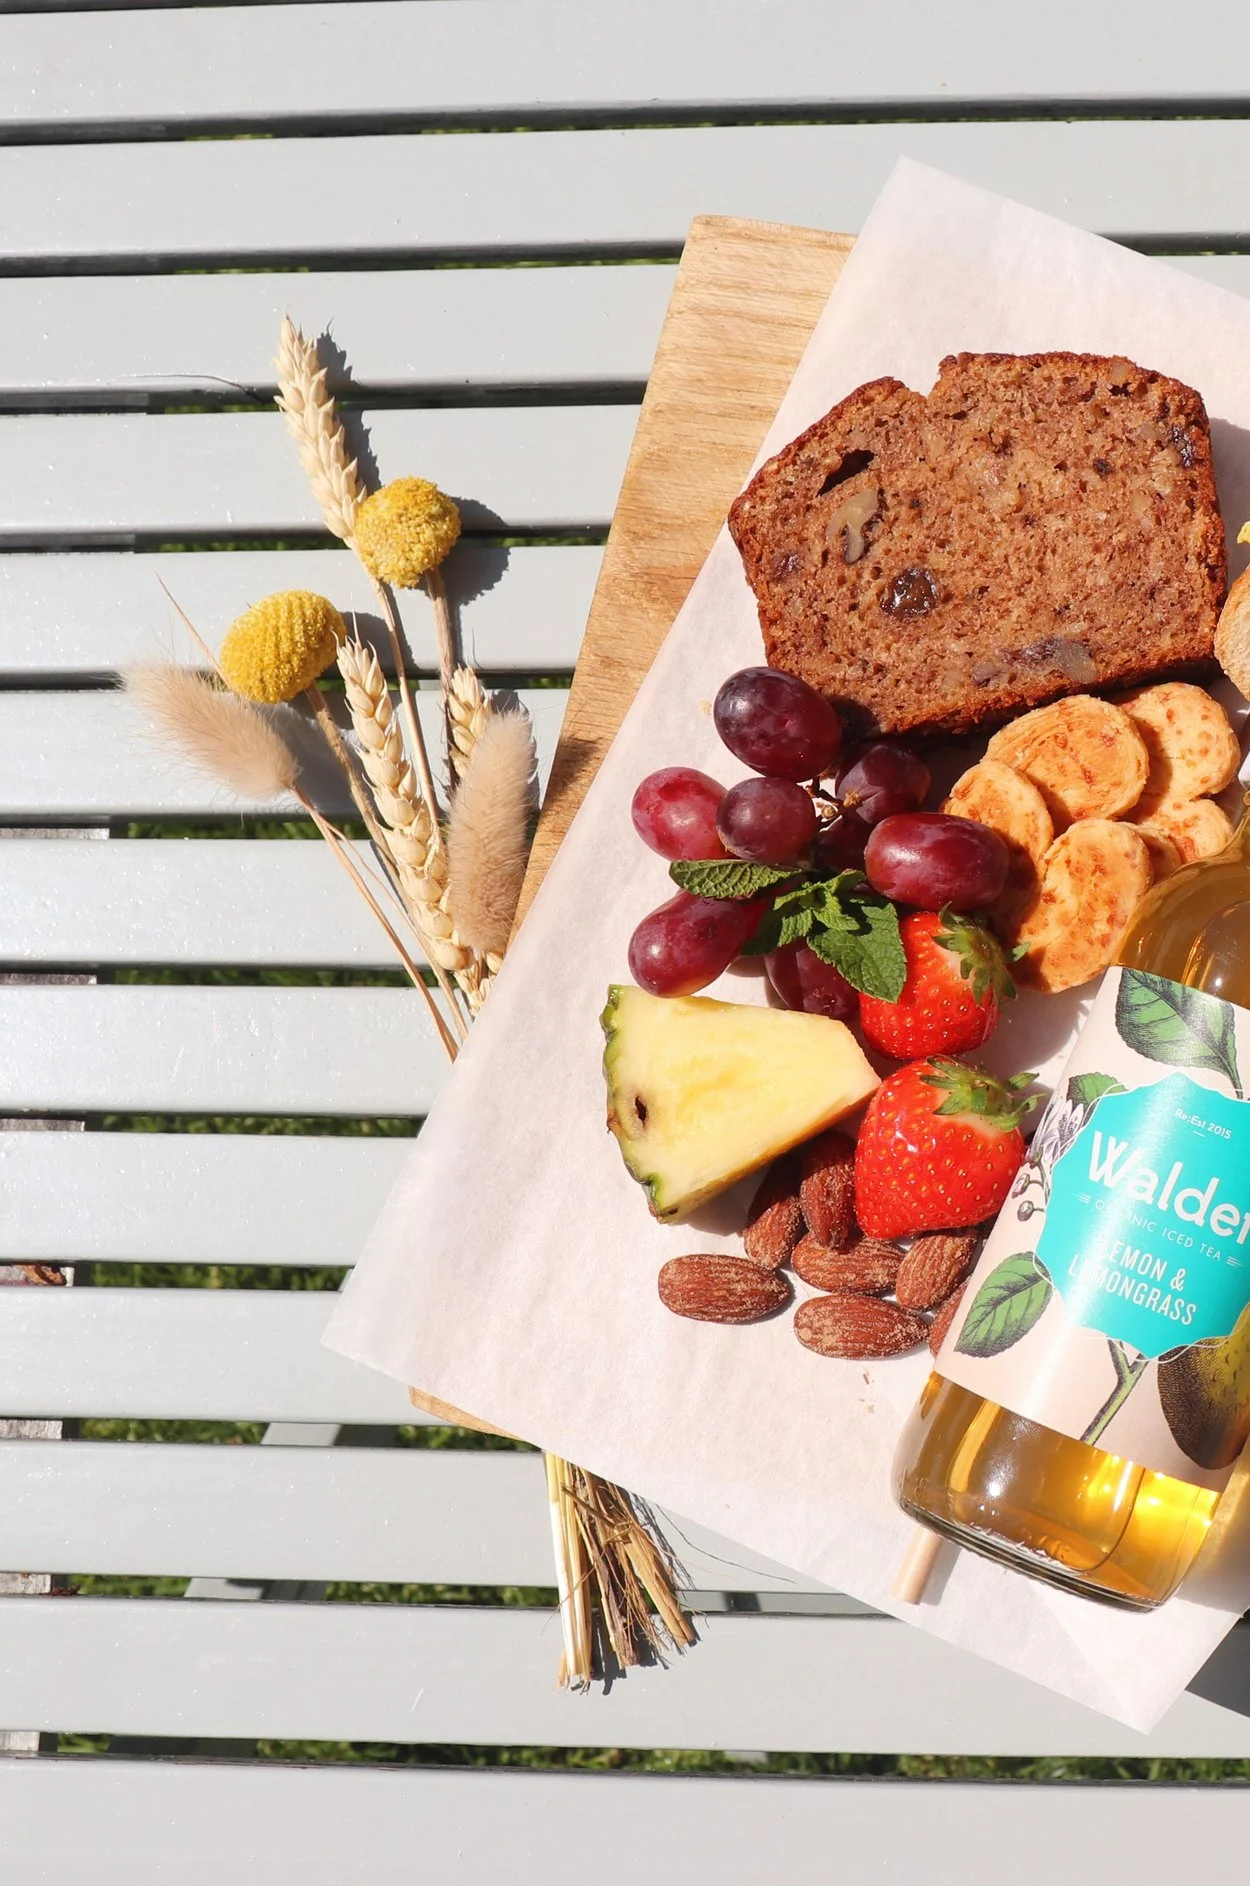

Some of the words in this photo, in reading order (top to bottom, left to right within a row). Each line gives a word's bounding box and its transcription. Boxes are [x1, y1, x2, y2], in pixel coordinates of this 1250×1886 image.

[1207, 1122, 1232, 1140] 2015
[1100, 1238, 1168, 1282] EMON
[1170, 1268, 1186, 1292] &
[1162, 1227, 1194, 1248] ICED
[1200, 1243, 1221, 1261] TEA
[1067, 1253, 1197, 1326] LMONGRASS
